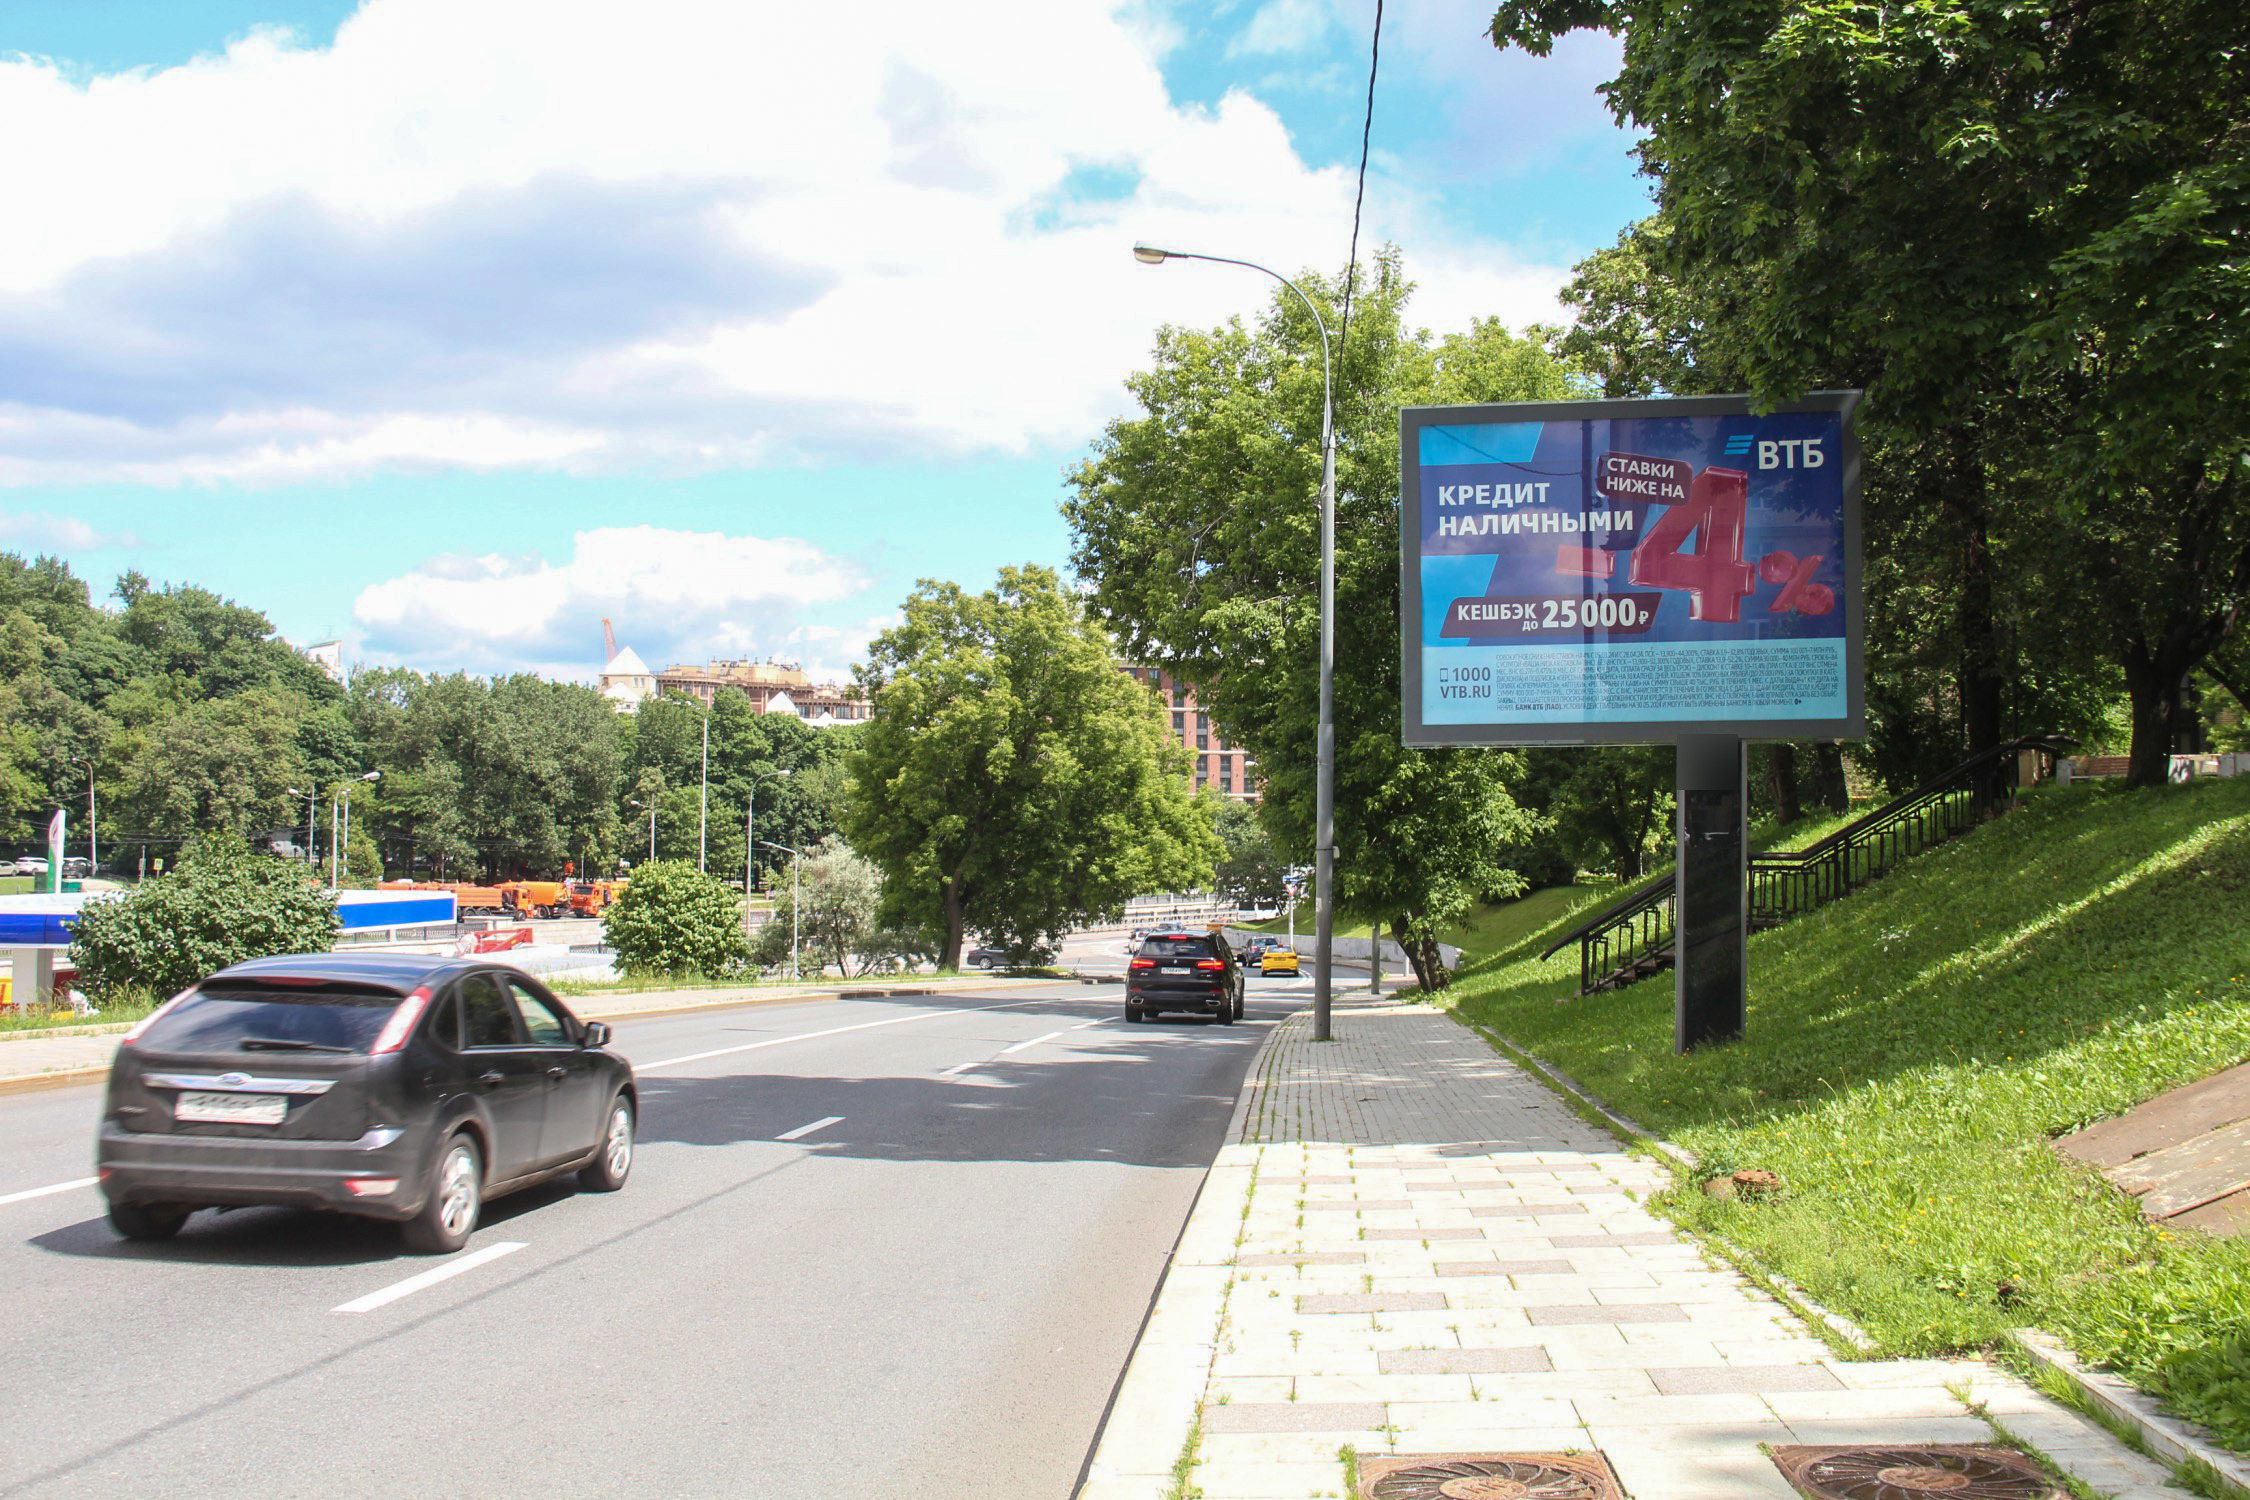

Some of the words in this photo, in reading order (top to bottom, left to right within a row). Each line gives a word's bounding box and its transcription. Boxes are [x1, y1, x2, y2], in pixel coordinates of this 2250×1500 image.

[1758, 439, 1824, 470] ВТБ
[1606, 457, 1675, 479] СТАВКИ
[1438, 481, 1550, 509] КРЕДИТ
[1606, 475, 1658, 496] НИЖЕ
[1660, 482, 1685, 499] НА
[1439, 510, 1634, 537] НАЛИЧНЫМИ
[1457, 602, 1537, 621] КЕШБЭК
[1521, 618, 1539, 631] ДО
[1452, 666, 1491, 681] 1000
[1440, 684, 1492, 700] VTB.RU
